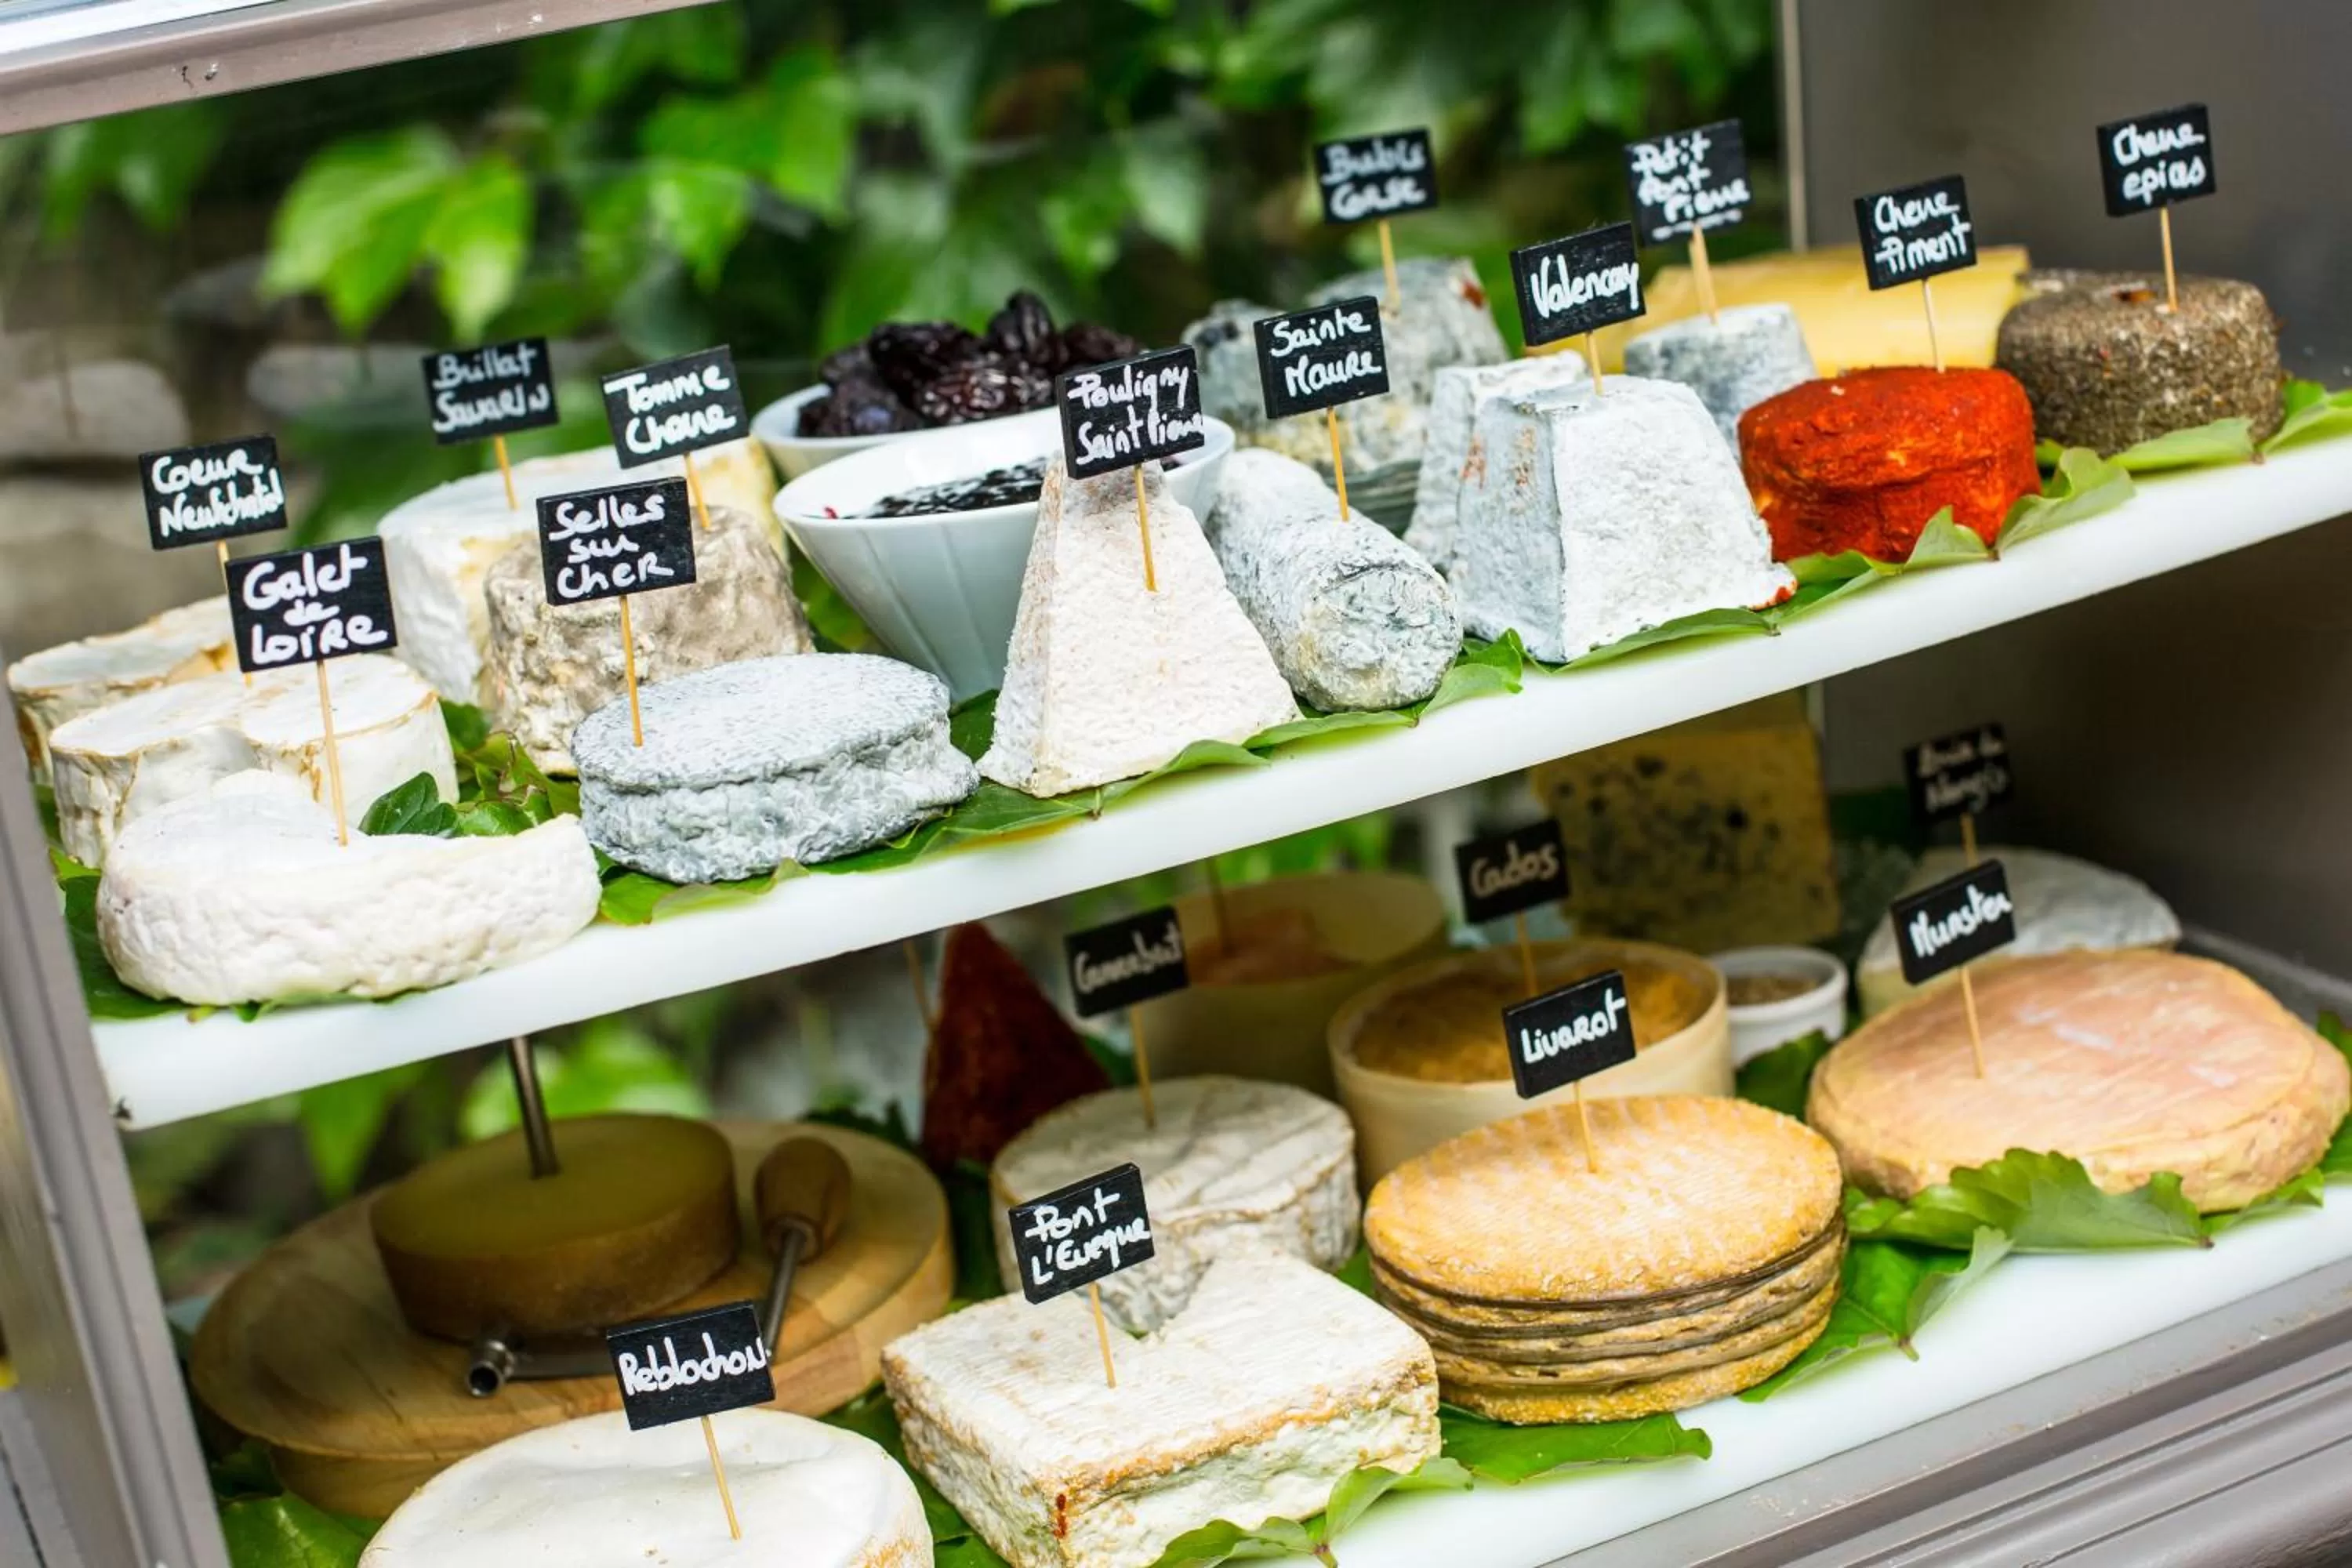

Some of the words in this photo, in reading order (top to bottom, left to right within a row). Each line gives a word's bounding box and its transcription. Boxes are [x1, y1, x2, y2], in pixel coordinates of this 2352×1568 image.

[1270, 307, 1371, 358] Sainte
[604, 365, 731, 413] Tomme
[1068, 364, 1189, 409] Pouligny
[1076, 405, 1143, 466] Saint
[549, 494, 665, 541] Selles
[243, 543, 368, 611] Galet
[1910, 884, 2013, 957] Munster
[1025, 1187, 1120, 1242] Pont
